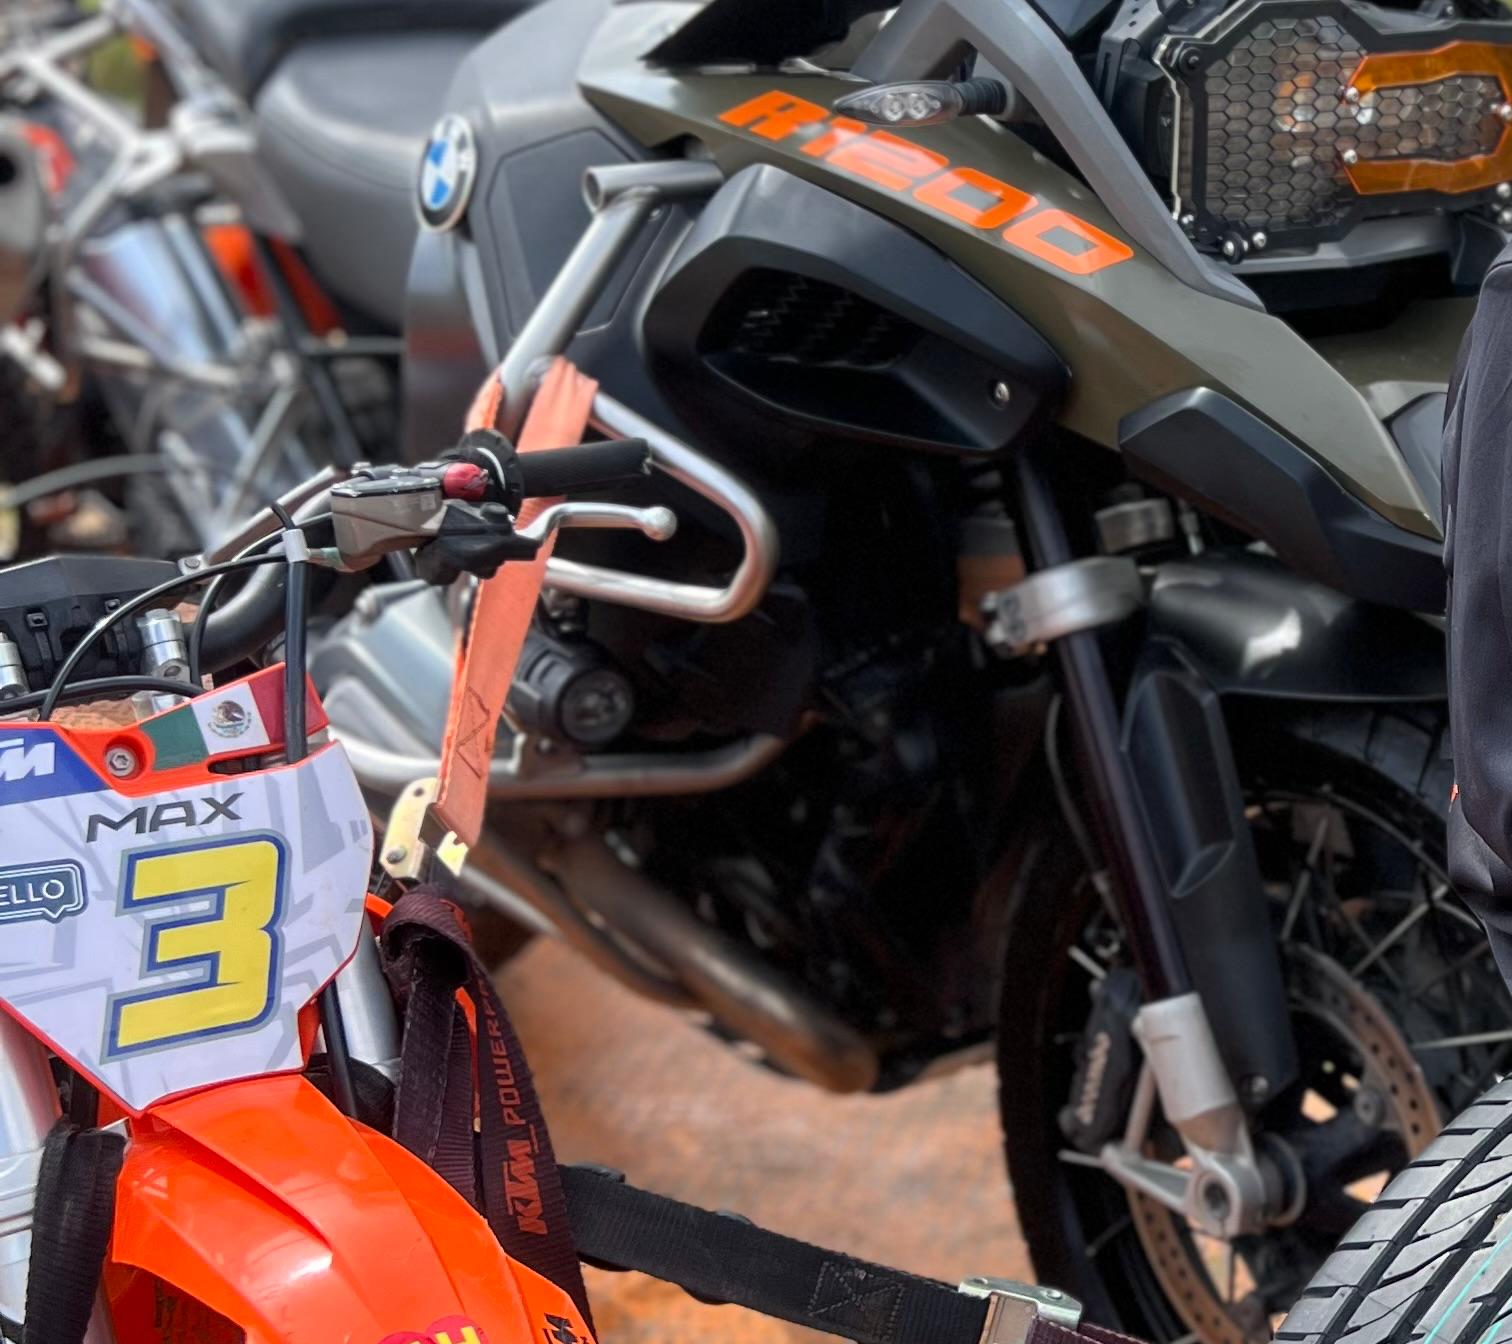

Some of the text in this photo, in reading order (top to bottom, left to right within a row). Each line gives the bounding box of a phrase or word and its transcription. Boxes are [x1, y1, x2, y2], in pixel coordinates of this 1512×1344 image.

[86, 792, 245, 843] MAX
[0, 879, 65, 905] ELLO
[104, 830, 289, 1061] 3
[503, 1133, 548, 1235] KTM
